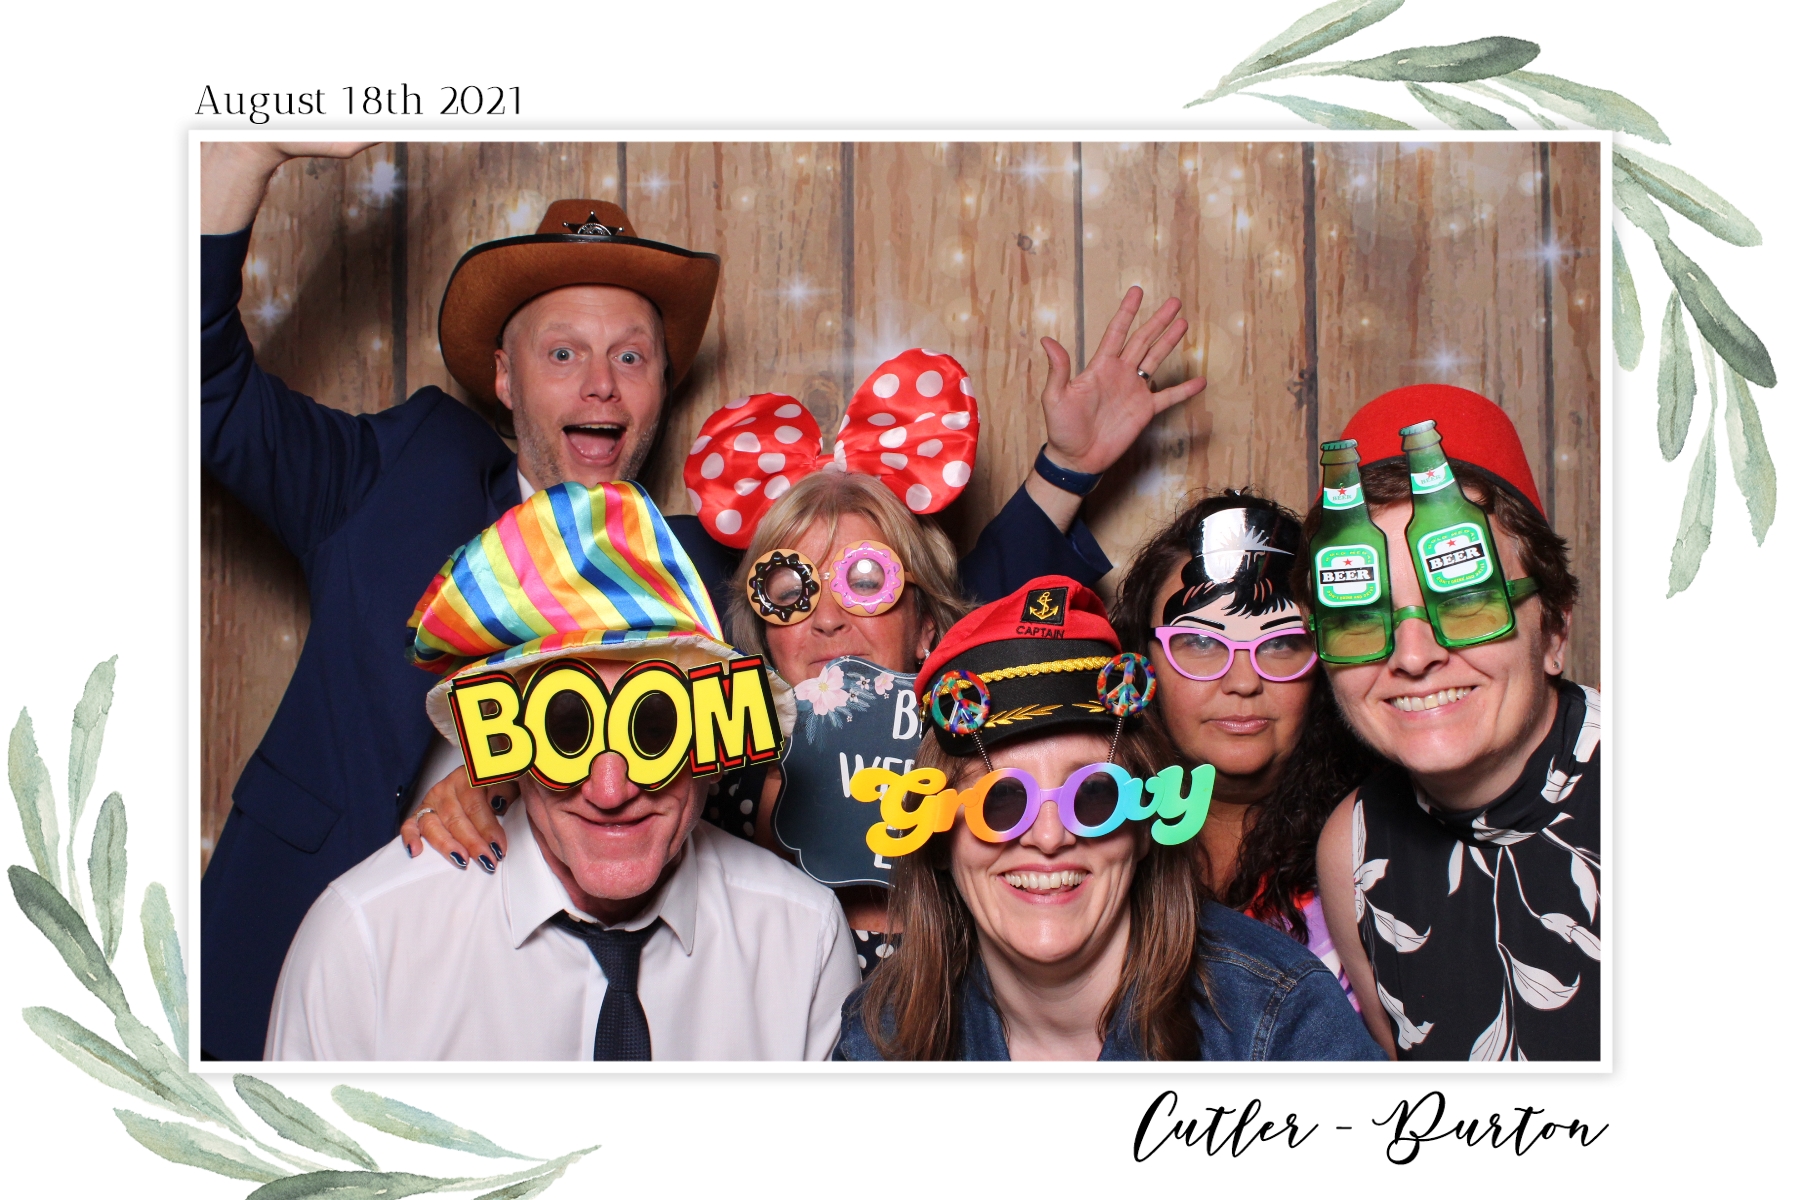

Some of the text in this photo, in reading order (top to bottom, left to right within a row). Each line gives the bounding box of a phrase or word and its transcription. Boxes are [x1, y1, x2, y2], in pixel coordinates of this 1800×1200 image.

[1421, 475, 1441, 484] BEER
[1429, 548, 1481, 570] BEER
[1322, 569, 1371, 583] BEER
[1016, 625, 1065, 639] CAPTAIN
[447, 654, 784, 792] BOOM
